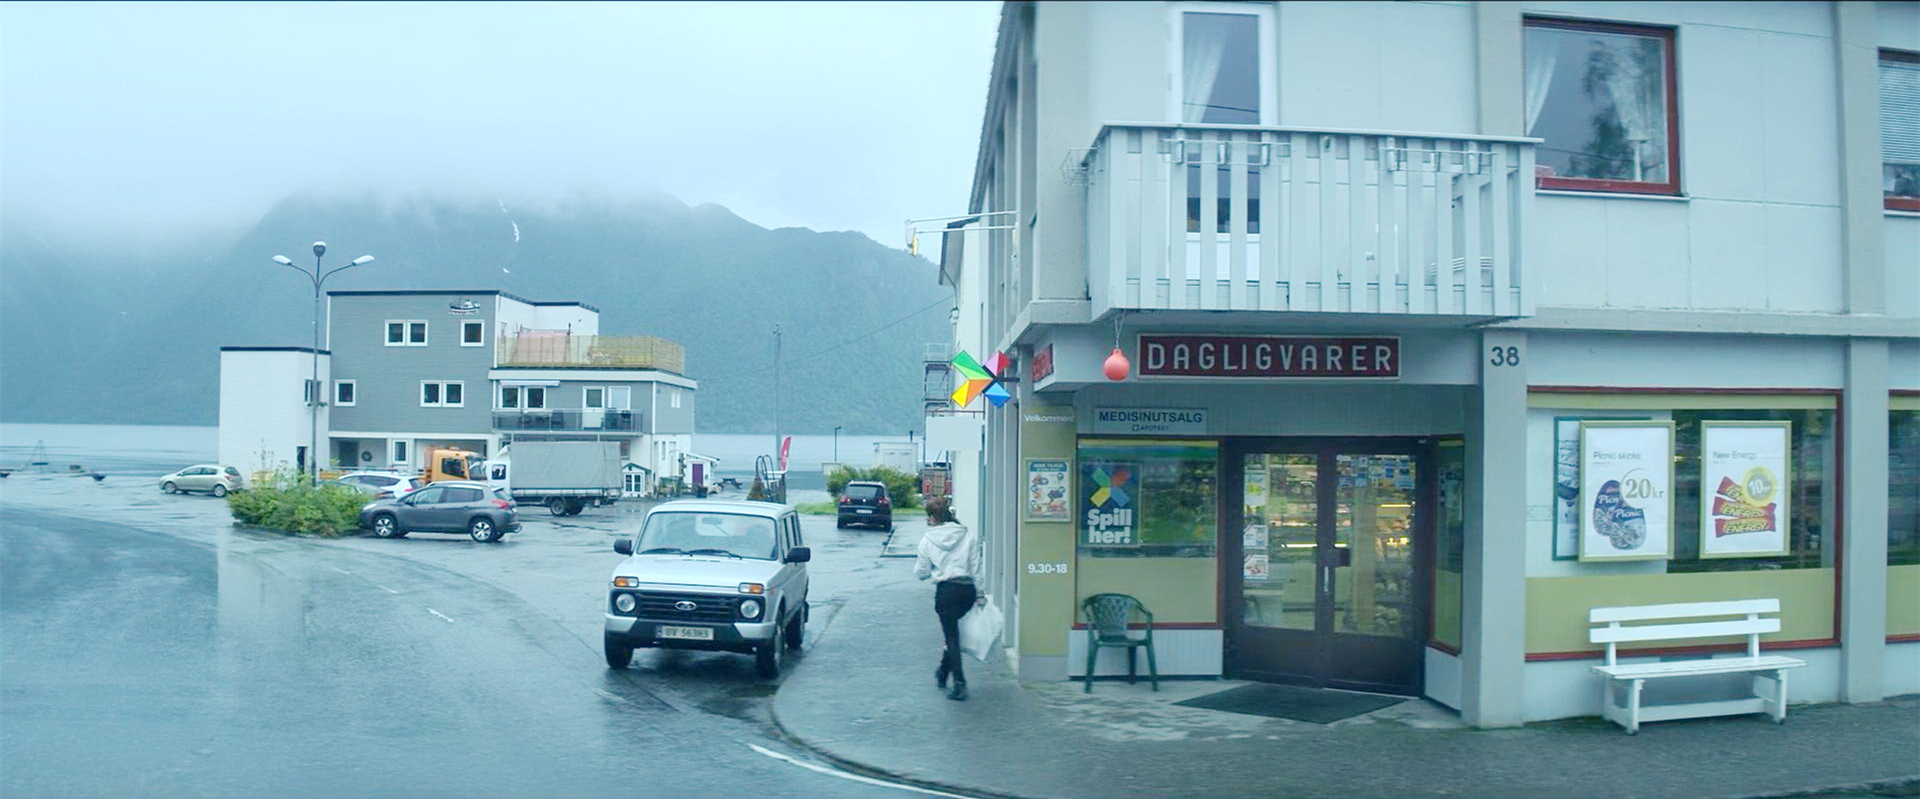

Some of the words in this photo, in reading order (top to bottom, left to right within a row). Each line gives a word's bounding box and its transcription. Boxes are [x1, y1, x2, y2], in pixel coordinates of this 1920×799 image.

[1147, 342, 1392, 371] DAGLIGVARER
[1490, 346, 1521, 367] 38
[1098, 410, 1203, 423] MEDISINUTSALG
[1713, 451, 1730, 459] New
[1625, 478, 1650, 499] 20
[1652, 486, 1665, 498] kr
[1748, 479, 1763, 495] 10
[1086, 507, 1133, 531] Spill
[1088, 526, 1131, 544] her!
[1027, 563, 1068, 574] 9.30-18
